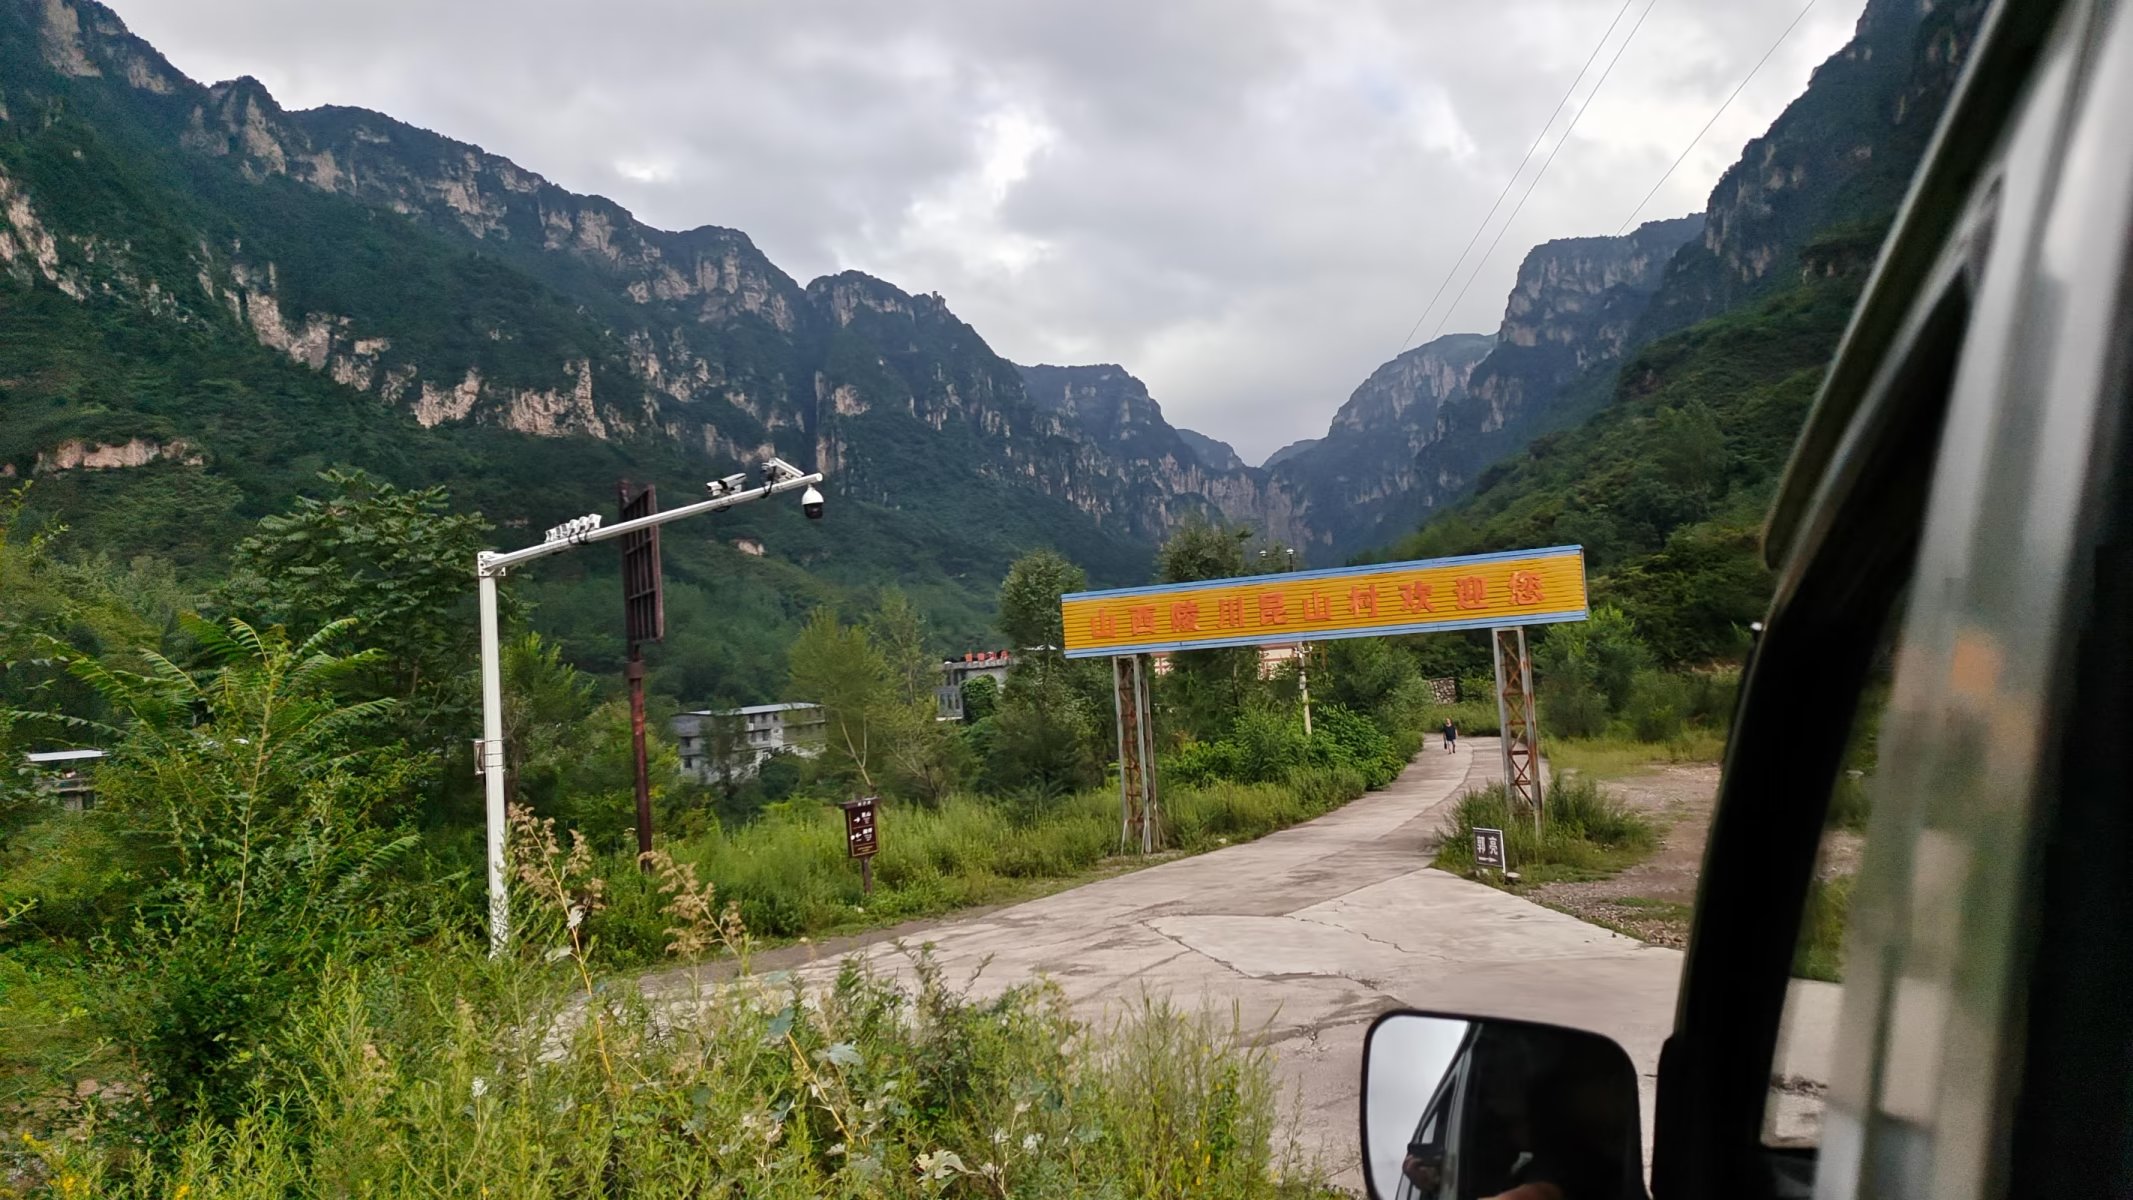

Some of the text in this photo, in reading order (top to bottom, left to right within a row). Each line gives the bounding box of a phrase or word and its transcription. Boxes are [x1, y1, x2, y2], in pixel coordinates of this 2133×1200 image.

[1090, 570, 1546, 639] 山西陵川昆山村欢迎您
[1476, 835, 1499, 856] 郭亮
